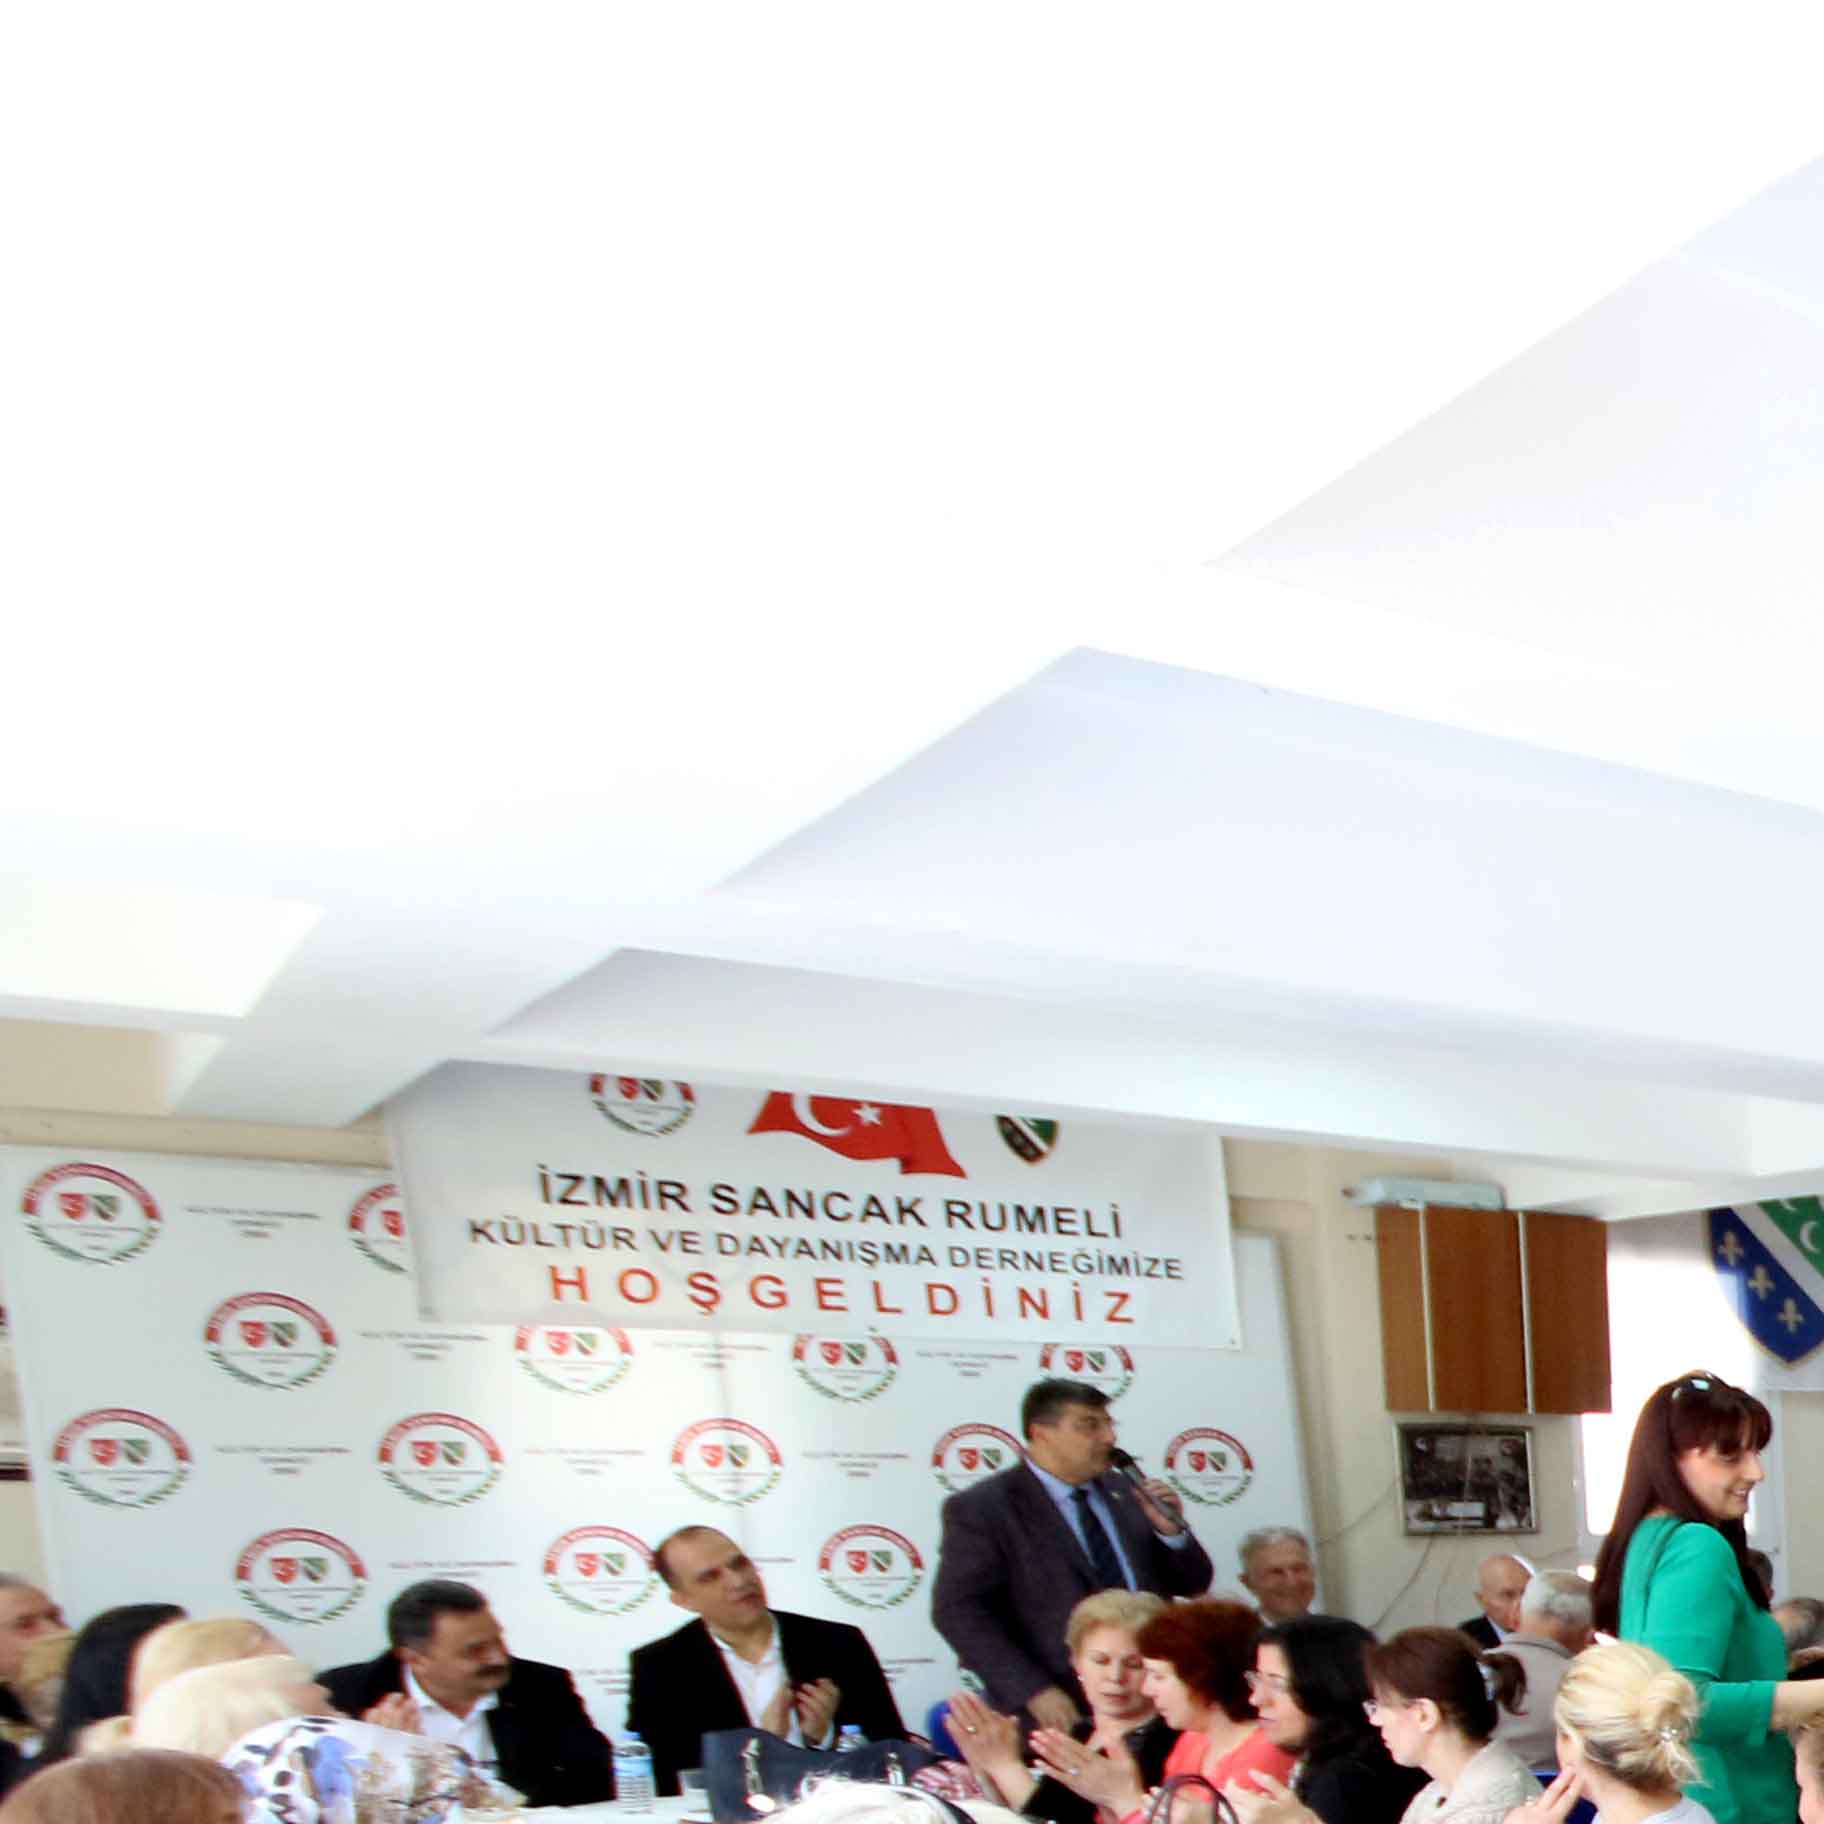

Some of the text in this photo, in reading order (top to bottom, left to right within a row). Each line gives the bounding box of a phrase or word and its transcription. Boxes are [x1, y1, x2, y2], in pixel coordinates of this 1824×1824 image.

[537, 1163, 1122, 1239] İZMİR SANCAK RUMELİ
[467, 1216, 1184, 1280] KÜLTÜR VE DAYANIŞMA DERNEĞİMİZE
[549, 1264, 1135, 1324] HOŞGELDİNİZ
